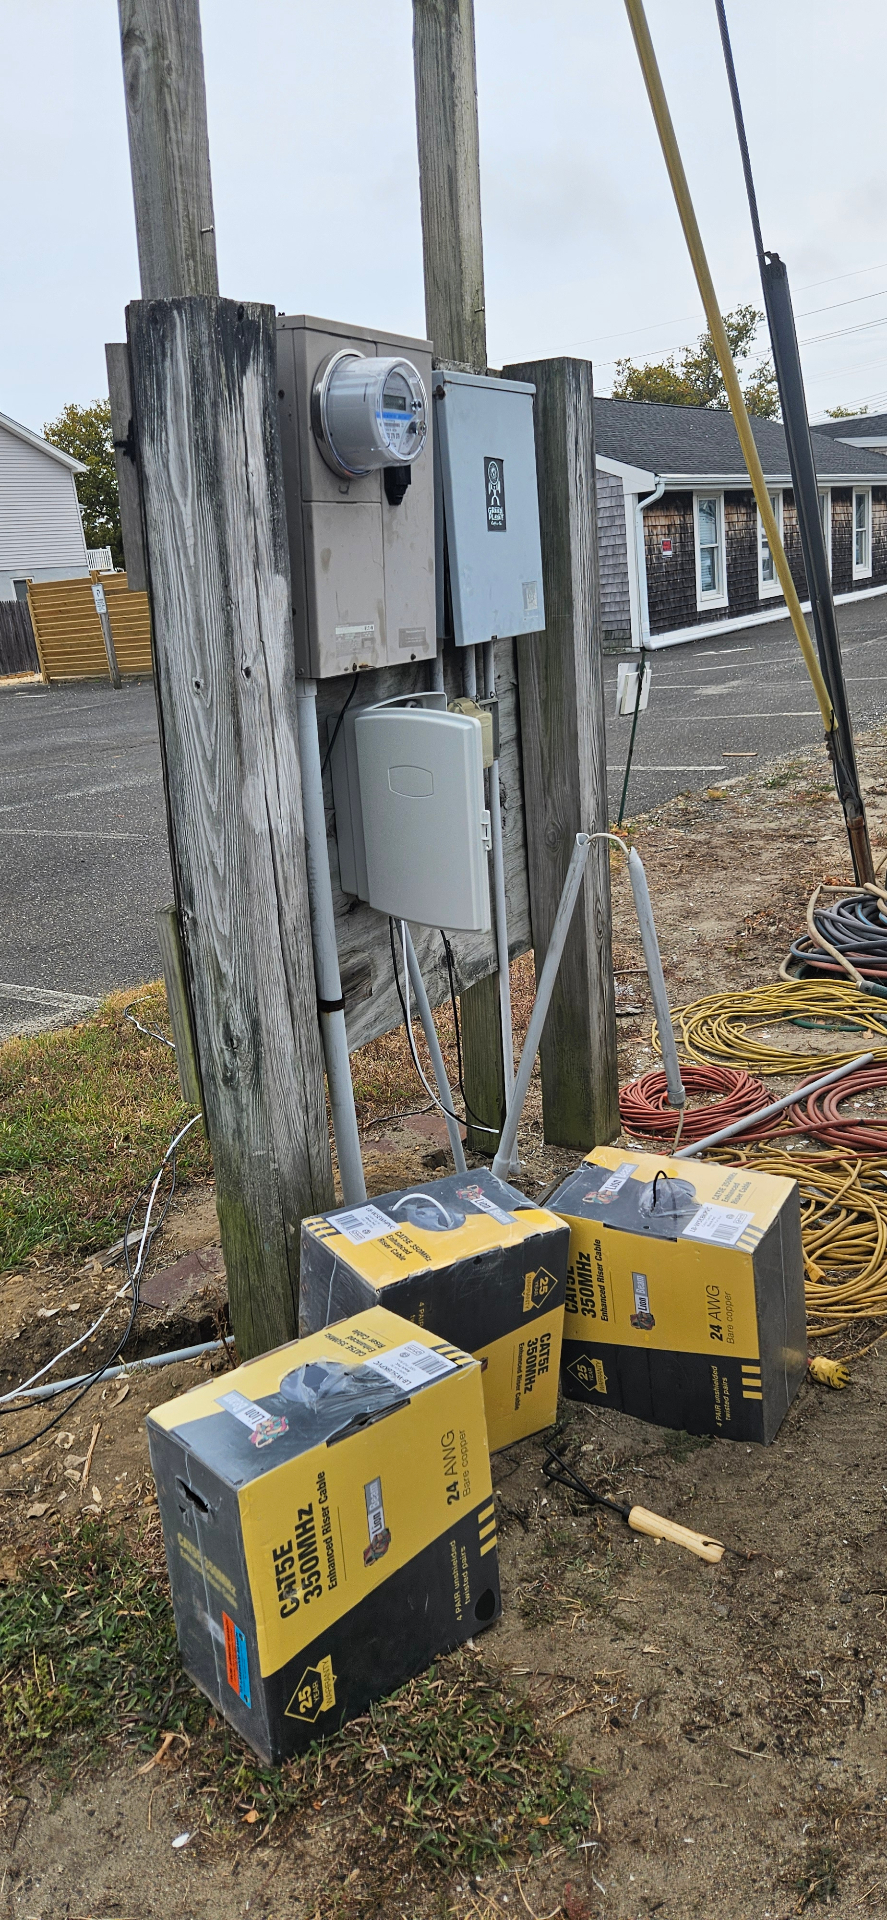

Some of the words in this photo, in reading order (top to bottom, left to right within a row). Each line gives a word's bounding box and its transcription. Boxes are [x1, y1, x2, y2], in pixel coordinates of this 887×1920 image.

[594, 1239, 602, 1261] Cable
[539, 1276, 549, 1295] 25
[576, 1251, 596, 1318] 350MHz
[636, 1275, 645, 1294] Beam
[598, 1284, 608, 1322] Enhanced
[638, 1297, 648, 1312] Lion
[705, 1284, 722, 1322] AWG
[724, 1291, 734, 1321] copper
[709, 1324, 723, 1342] 24
[726, 1324, 735, 1344] Bare
[517, 1342, 525, 1374] Enhanced
[524, 1337, 539, 1394] 350MHz
[538, 1332, 551, 1376] CAT5E
[576, 1364, 588, 1381] 25
[711, 1365, 720, 1403] unshielded
[722, 1377, 730, 1395] pairs
[441, 1430, 458, 1476] AWG
[459, 1430, 470, 1468] copper
[316, 1470, 328, 1504] Cable
[370, 1482, 379, 1511] Beam
[447, 1480, 460, 1506] 24
[463, 1472, 471, 1497] Bare
[322, 1505, 332, 1536] Riser
[372, 1511, 382, 1534] Lion
[295, 1502, 323, 1605] 350MHz
[323, 1535, 338, 1591] Enhanced
[450, 1539, 460, 1588] unshielded
[460, 1546, 470, 1571] pairs
[272, 1539, 300, 1619] CAT5E
[461, 1571, 471, 1605] twisted
[298, 1685, 313, 1714] 25
